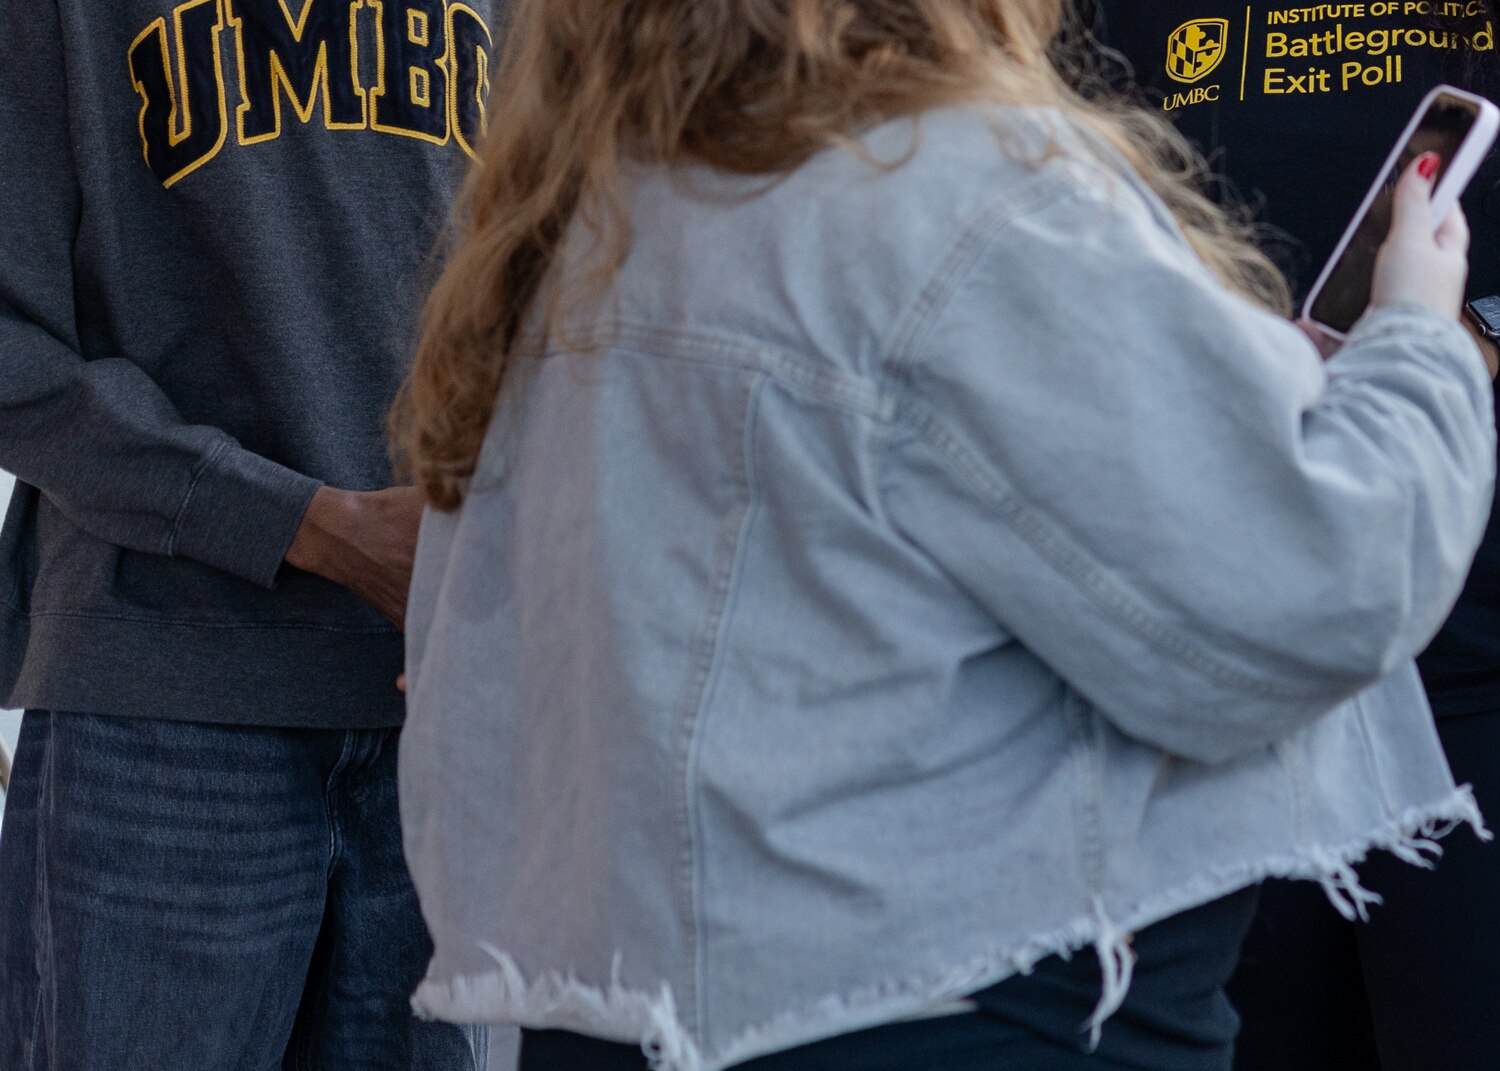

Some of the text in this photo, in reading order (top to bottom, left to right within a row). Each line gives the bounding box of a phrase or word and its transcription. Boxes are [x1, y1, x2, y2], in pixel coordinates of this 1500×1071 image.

[1267, 3, 1366, 25] INSTITUTE
[1370, 1, 1399, 17] OF
[1262, 55, 1402, 95] Exit Poll
[1163, 84, 1220, 111] UMBC
